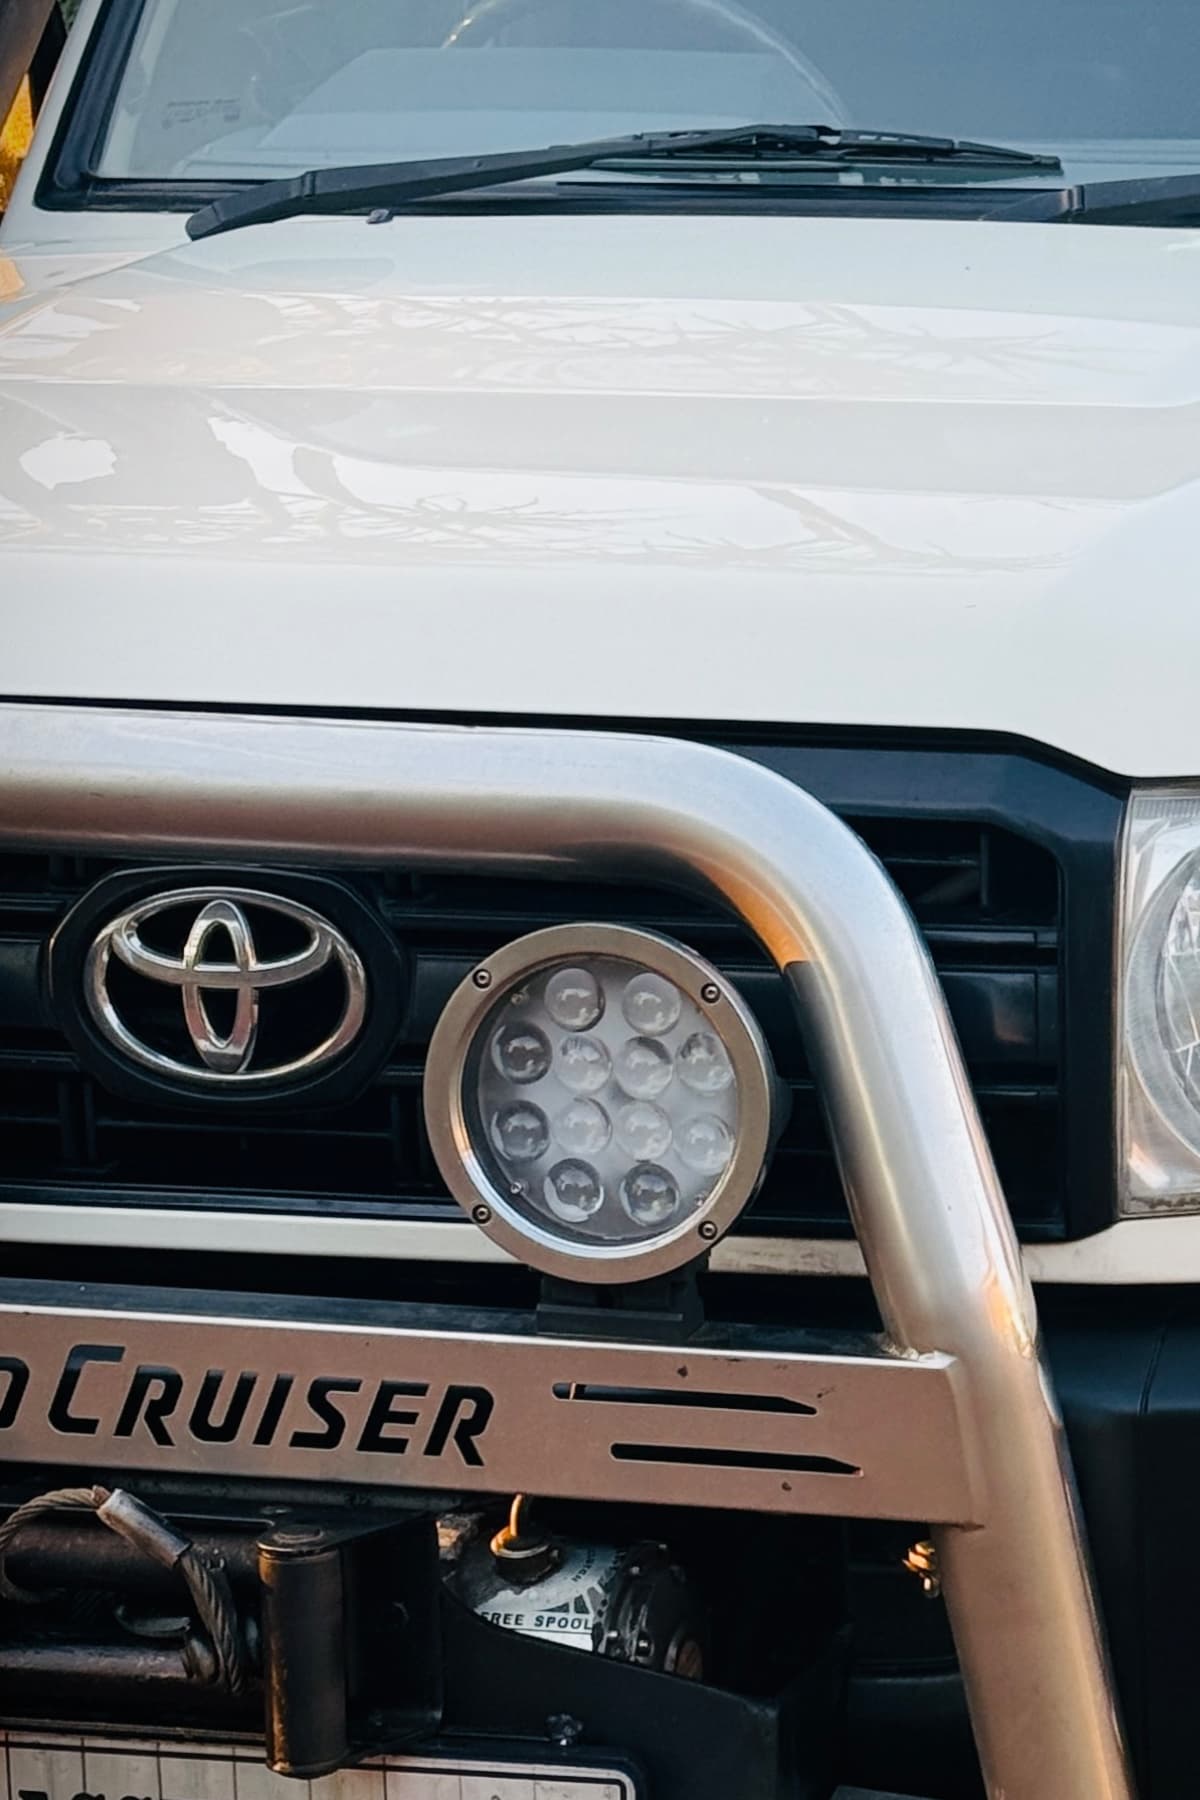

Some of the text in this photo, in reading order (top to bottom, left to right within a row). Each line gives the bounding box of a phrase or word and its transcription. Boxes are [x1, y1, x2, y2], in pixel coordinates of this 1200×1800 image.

[47, 1344, 496, 1467] CRUISER
[480, 1610, 593, 1631] FREE SPOOL
